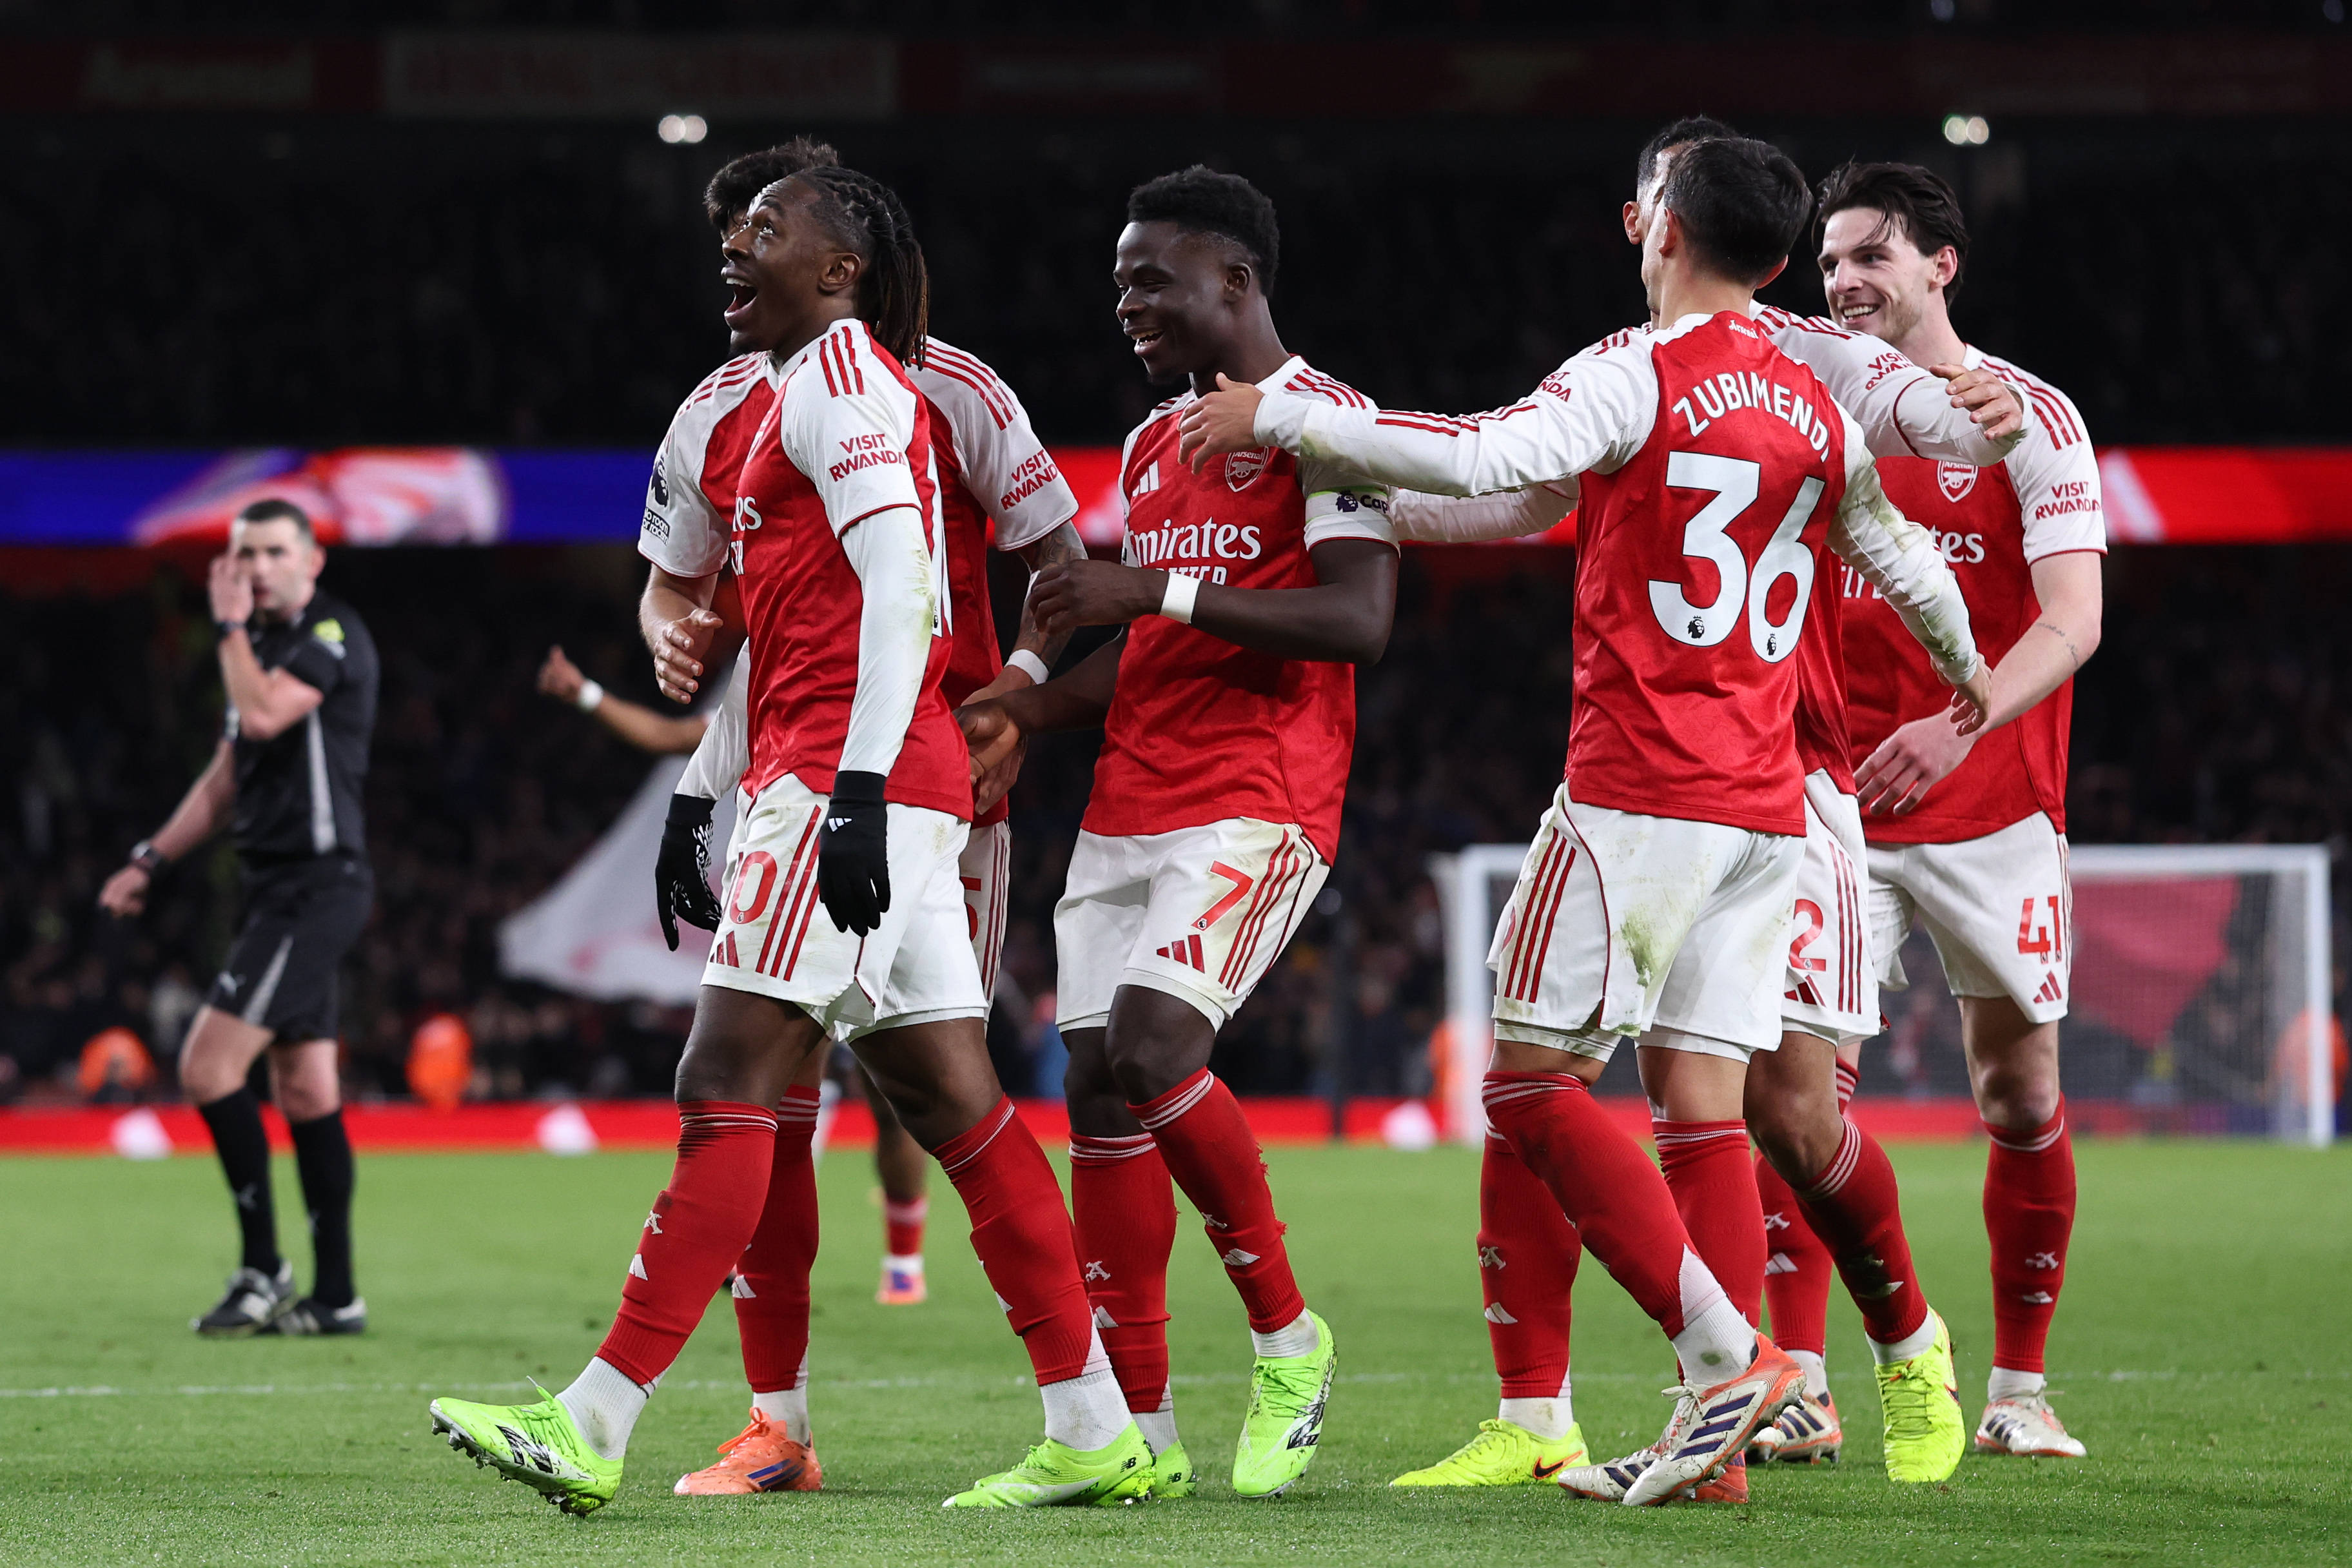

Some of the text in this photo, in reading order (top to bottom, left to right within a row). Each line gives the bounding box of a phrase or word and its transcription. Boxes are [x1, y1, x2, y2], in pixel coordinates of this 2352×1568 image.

[839, 433, 886, 454] VISIT
[828, 450, 908, 482] RWANDA
[1011, 449, 1048, 482] VISIT
[2035, 498, 2101, 520] RWANDA
[2052, 481, 2089, 498] VISIT
[1130, 516, 1261, 568] mirates
[1647, 450, 1826, 663] 36
[1191, 860, 1255, 932] 7
[1788, 898, 1827, 972] 2
[2017, 895, 2062, 965] 41
